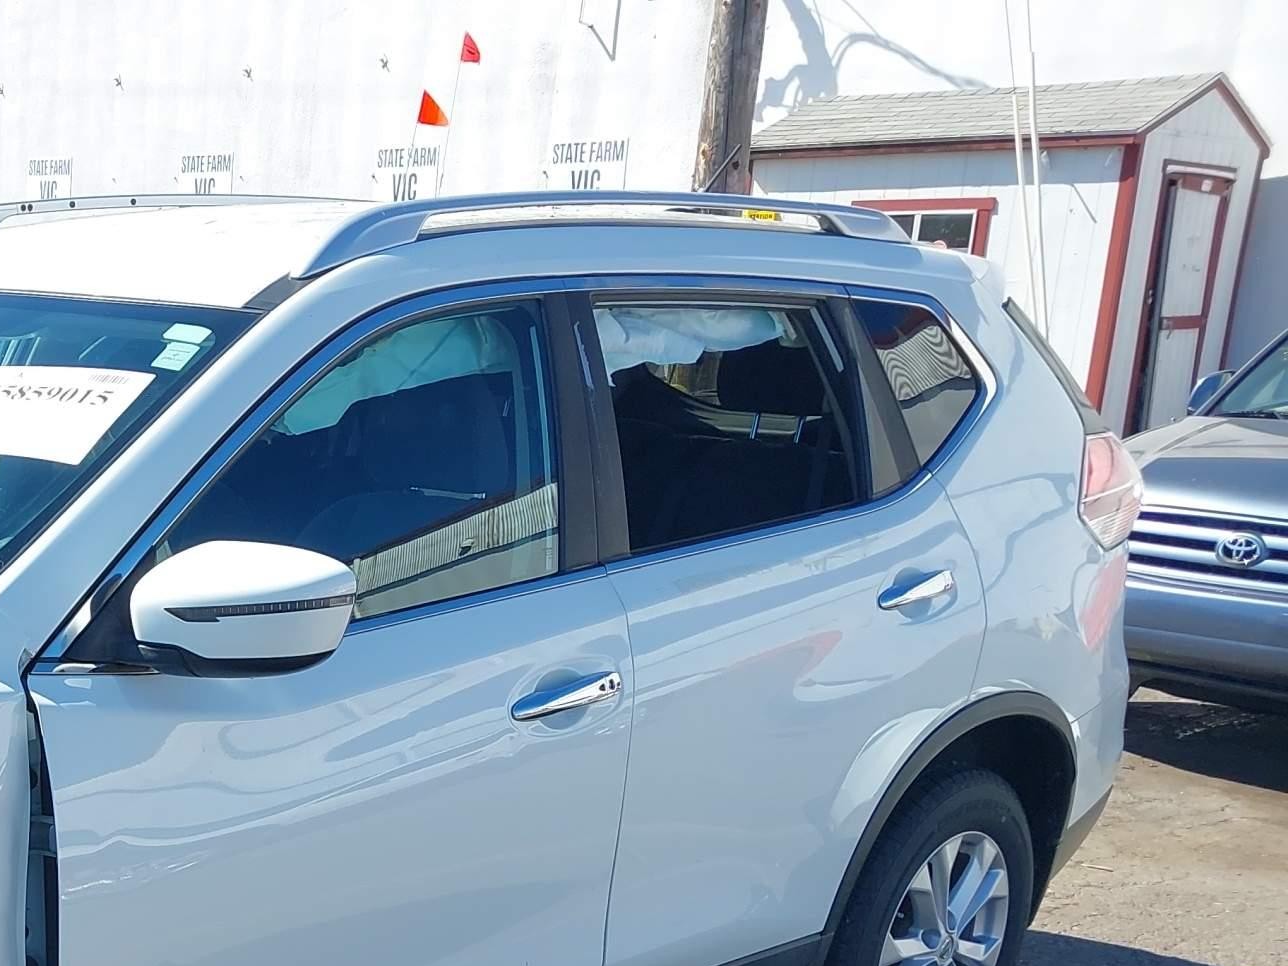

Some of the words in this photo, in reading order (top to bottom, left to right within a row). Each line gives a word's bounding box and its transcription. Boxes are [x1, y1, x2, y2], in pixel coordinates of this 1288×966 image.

[377, 148, 405, 169] STATE
[407, 147, 436, 168] FARM
[553, 142, 587, 165] STATE
[588, 140, 624, 163] FARM
[28, 159, 48, 177] STATE
[49, 159, 70, 176] FARM
[181, 155, 205, 174] STATE
[206, 154, 231, 173] FARM
[39, 180, 58, 200] VIC
[392, 173, 418, 202] VIC
